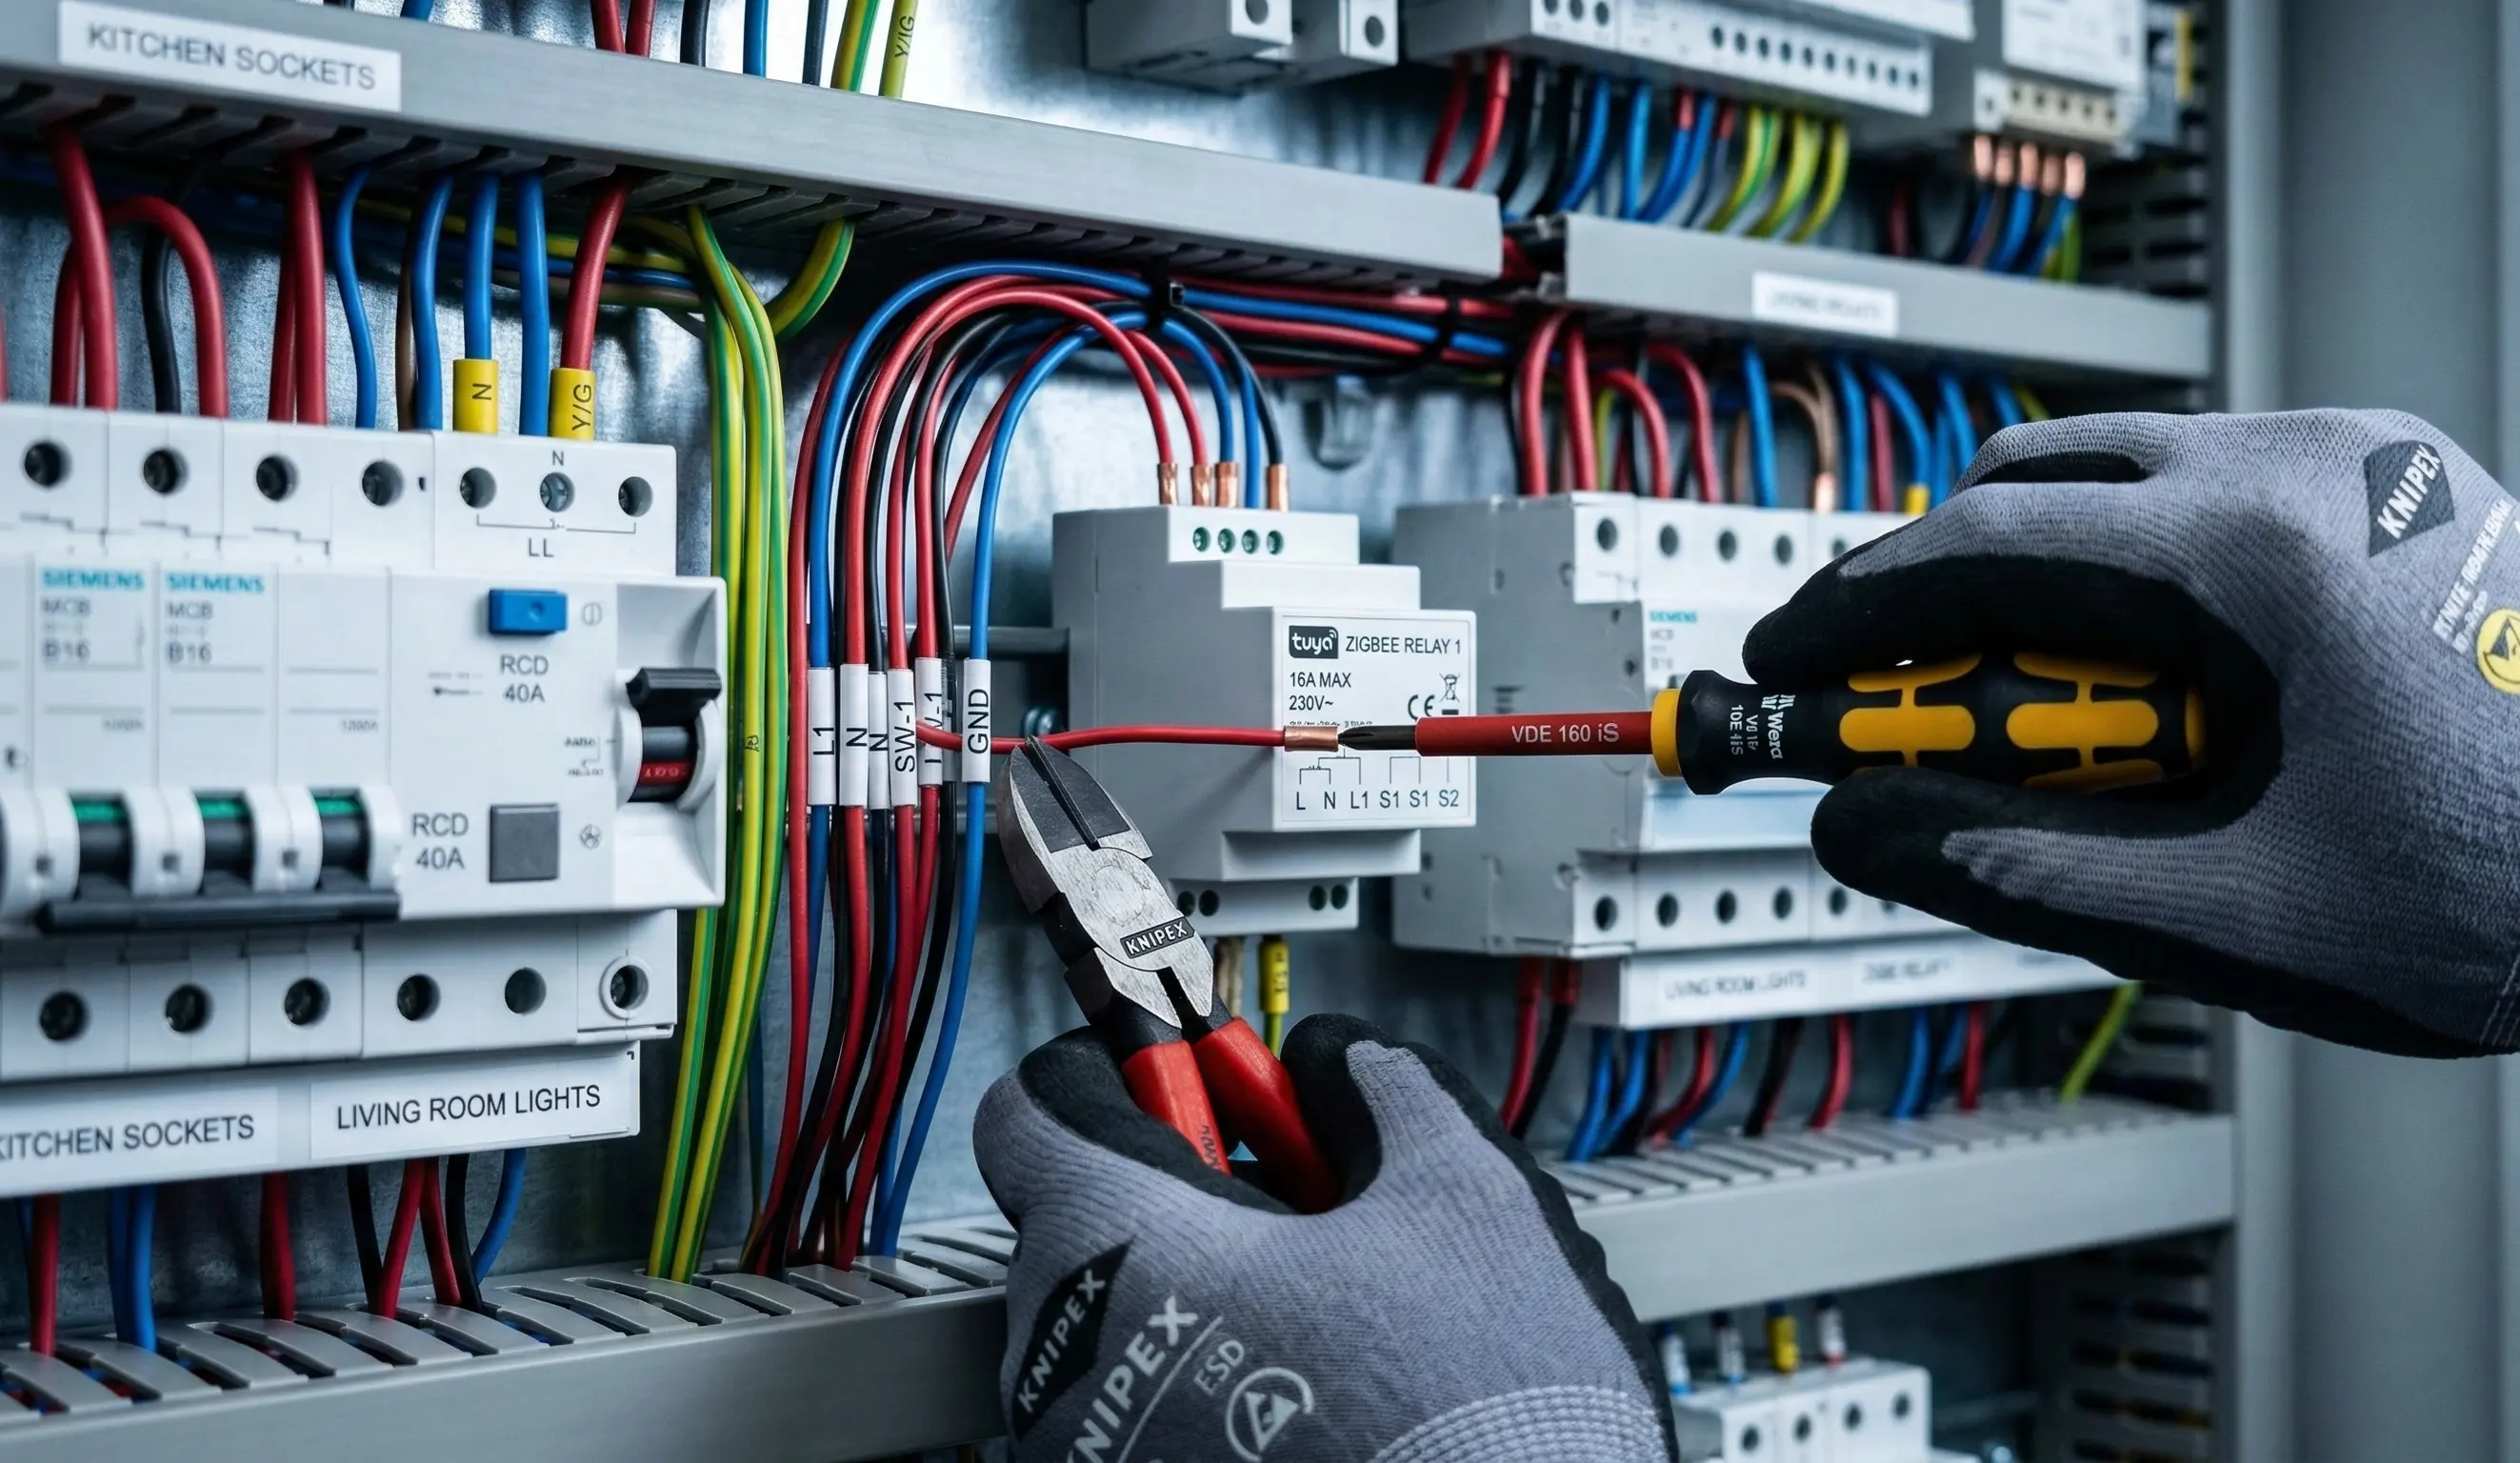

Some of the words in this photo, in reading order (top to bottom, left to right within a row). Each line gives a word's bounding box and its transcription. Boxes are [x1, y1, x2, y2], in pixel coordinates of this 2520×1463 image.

[87, 24, 227, 68] KITCHEN
[235, 45, 377, 91] SOCKETS
[471, 383, 491, 400] N
[571, 383, 592, 431] Y/G
[552, 450, 564, 466] N
[2377, 444, 2441, 540] KNIPEX
[40, 570, 145, 591] SIEMENS
[167, 574, 266, 594] SIEMENS
[1291, 632, 1335, 655] tuya
[1346, 636, 1400, 653] ZIGBEE
[1405, 637, 1451, 654] RELAY
[1454, 639, 1461, 653] 1
[499, 654, 550, 676] RCD
[1290, 671, 1316, 689] 16A
[1319, 672, 1351, 688] MAX
[503, 685, 546, 703] 40A
[968, 689, 990, 754] GND
[1511, 725, 1551, 742] VDE
[1559, 724, 1590, 742] 160
[1598, 723, 1620, 742] iS
[812, 727, 835, 755] L1
[846, 728, 868, 747] N
[869, 733, 889, 752] N
[893, 702, 915, 772] SW-1
[1768, 711, 1784, 760] Wera
[1296, 792, 1306, 810] L
[1324, 792, 1336, 810] N
[1350, 791, 1368, 809] L1
[1379, 790, 1399, 809] S1
[1410, 790, 1429, 808] S1
[1438, 789, 1459, 808] S2
[411, 812, 469, 837] RCD
[416, 847, 465, 870] 40A
[1126, 921, 1188, 955] KNIPEX
[337, 1099, 421, 1130] LIVING
[430, 1092, 506, 1121] ROOM
[515, 1084, 601, 1113] LIGHTS
[123, 1114, 254, 1150] SOCKETS
[1017, 1268, 1106, 1413] KNIPEX
[1067, 1295, 1199, 1463] NIPEX
[1194, 1339, 1245, 1396] ESD
